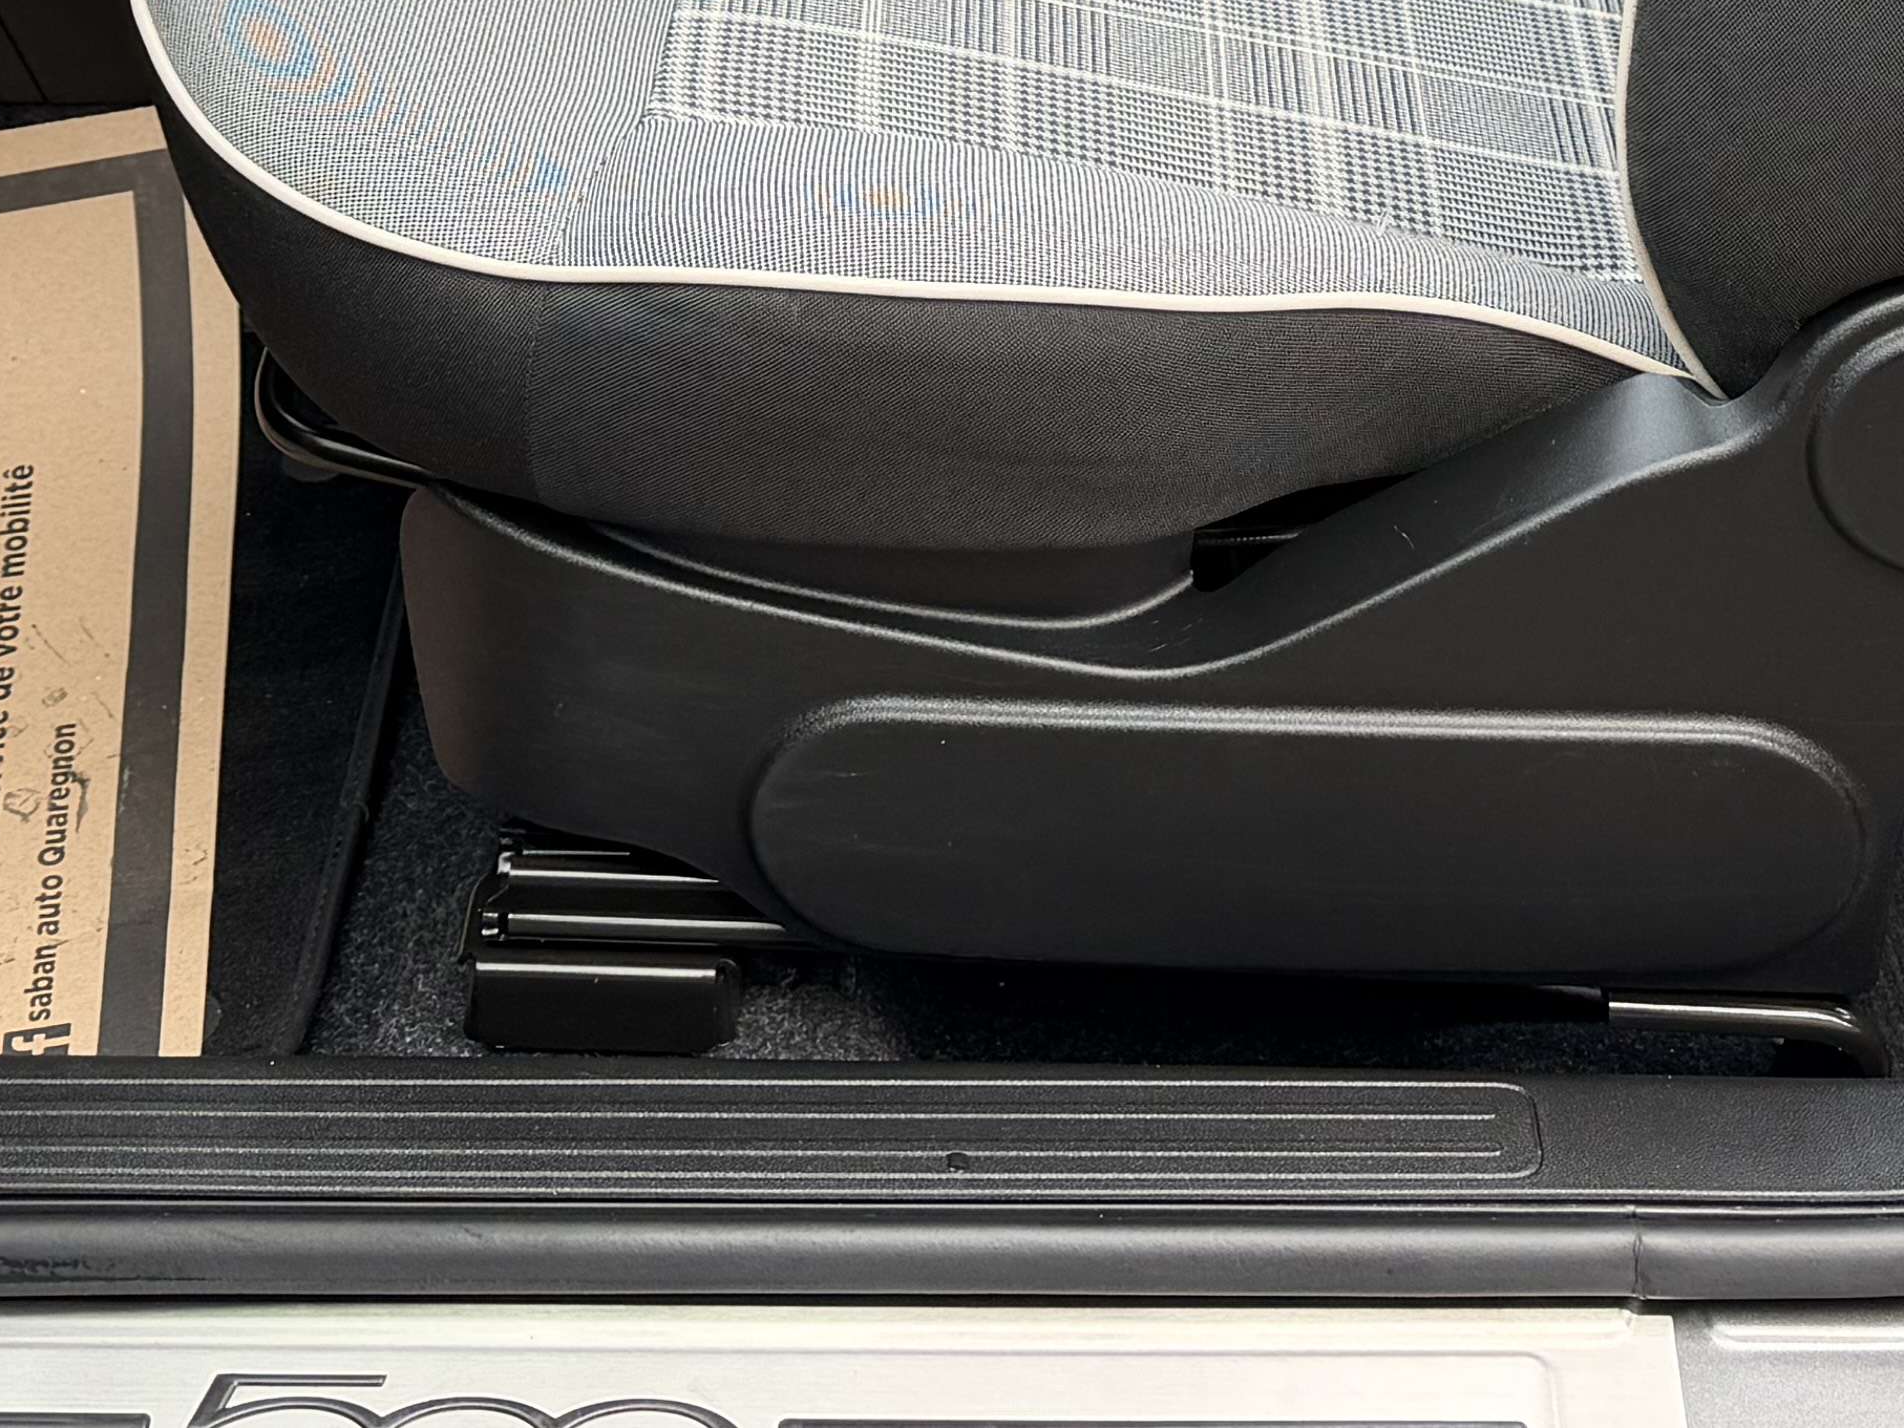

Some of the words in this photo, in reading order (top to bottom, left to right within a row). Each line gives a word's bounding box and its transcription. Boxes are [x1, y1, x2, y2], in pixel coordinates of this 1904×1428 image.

[38, 721, 78, 868] Quaregnon
[34, 874, 64, 937] auto
[24, 943, 58, 1024] saban
